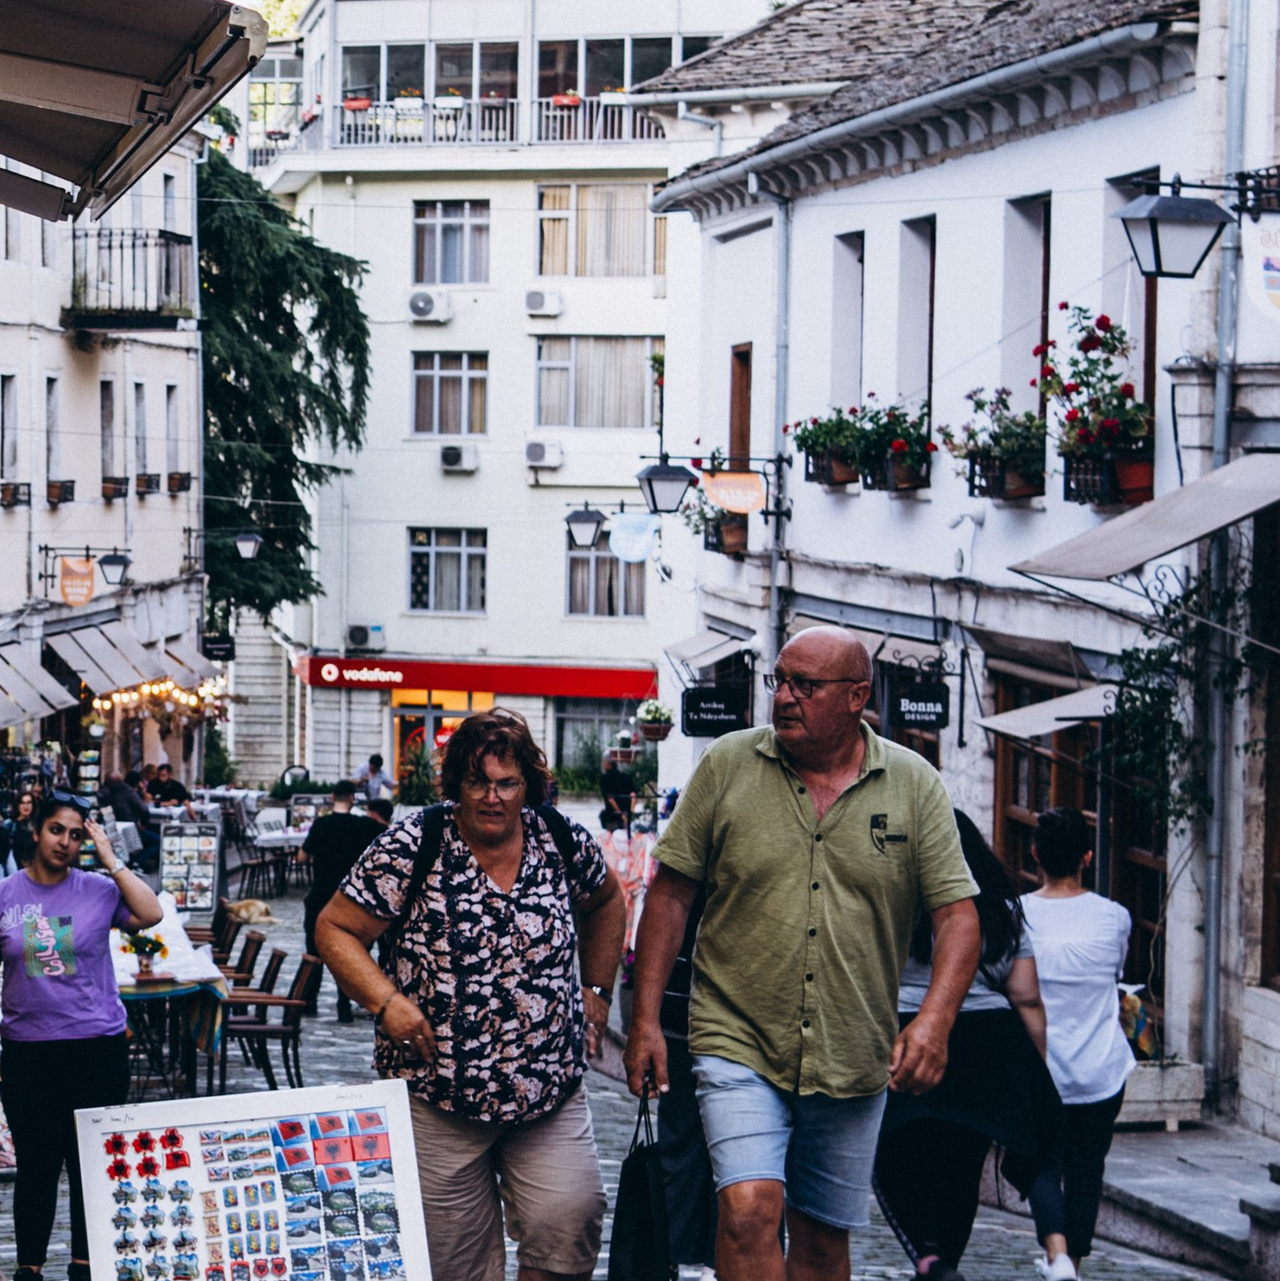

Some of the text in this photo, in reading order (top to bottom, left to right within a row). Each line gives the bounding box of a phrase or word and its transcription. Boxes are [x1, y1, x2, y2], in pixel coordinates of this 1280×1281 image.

[342, 666, 404, 683] vodafone
[900, 698, 943, 713] Bonna
[904, 712, 937, 721] DESIGN
